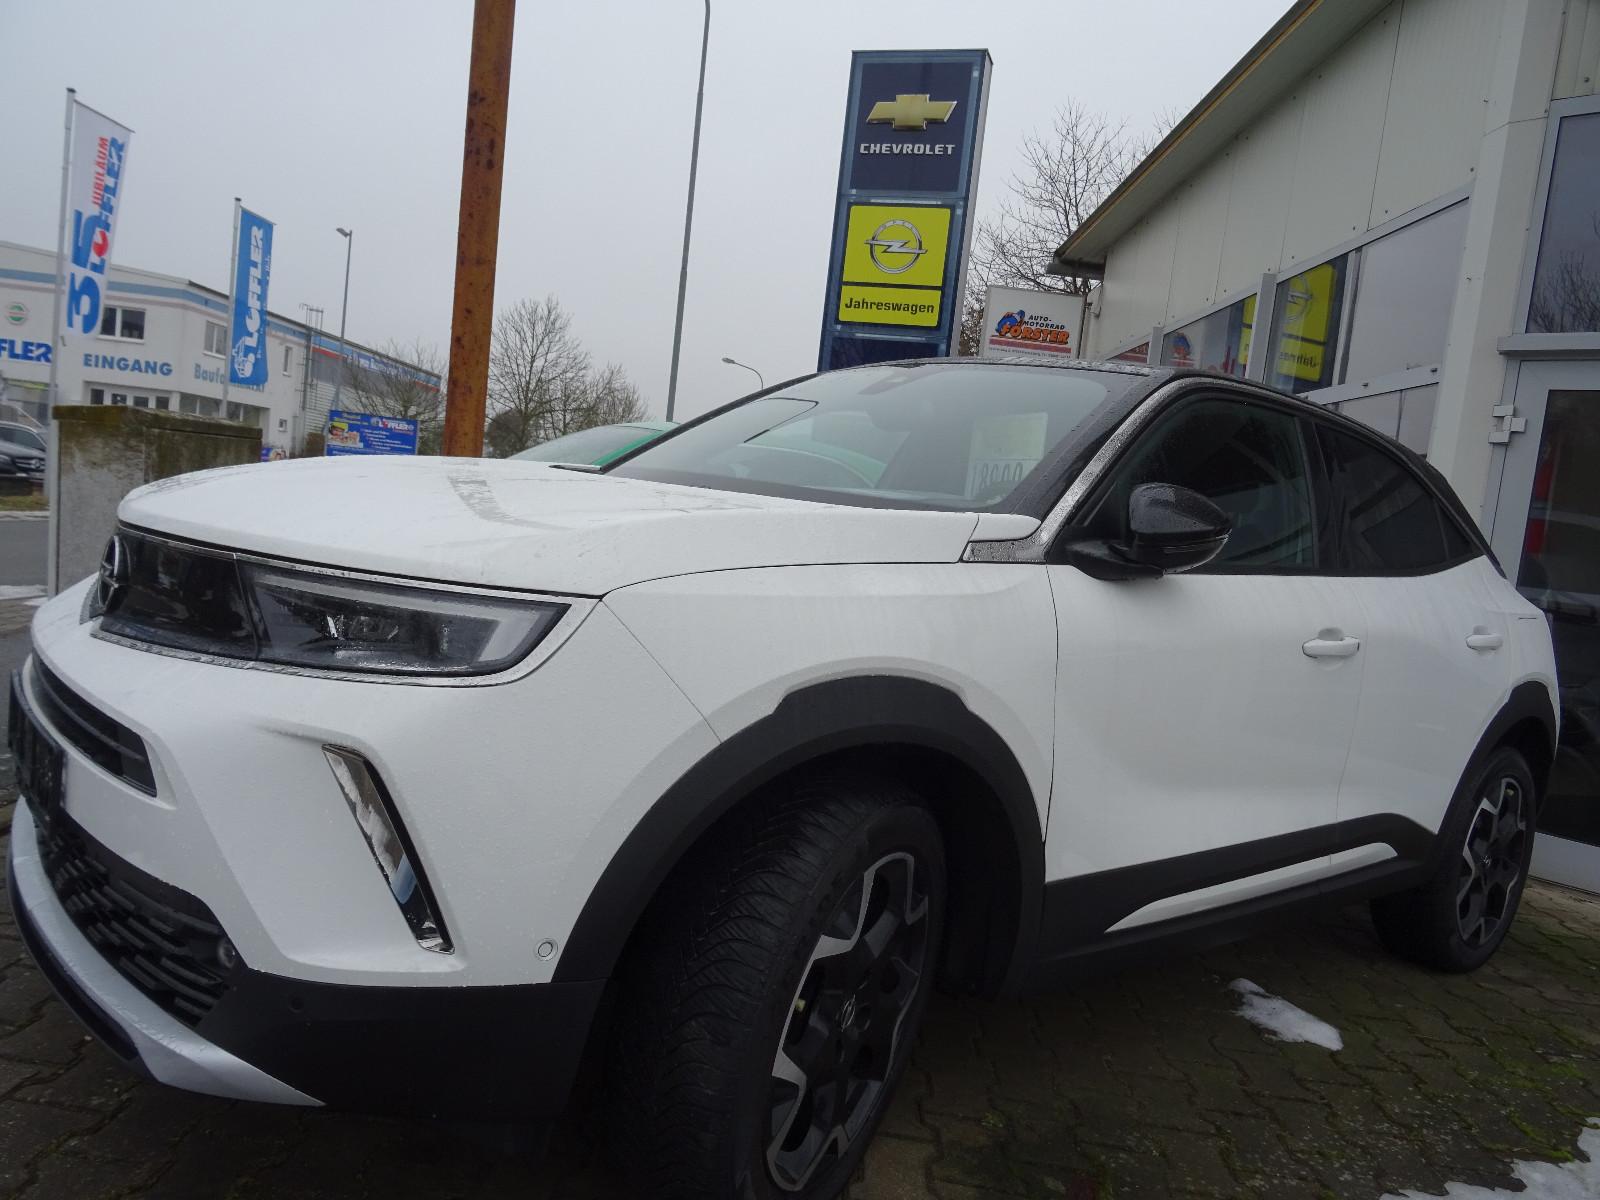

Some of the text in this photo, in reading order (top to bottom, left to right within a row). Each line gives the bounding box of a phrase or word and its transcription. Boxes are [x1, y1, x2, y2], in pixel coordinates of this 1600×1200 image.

[859, 143, 956, 156] CHEVROLET
[67, 209, 102, 334] 35
[844, 297, 935, 315] Jahreswagen
[1022, 320, 1065, 330] MOTORRAD
[83, 353, 173, 376] EINGANG
